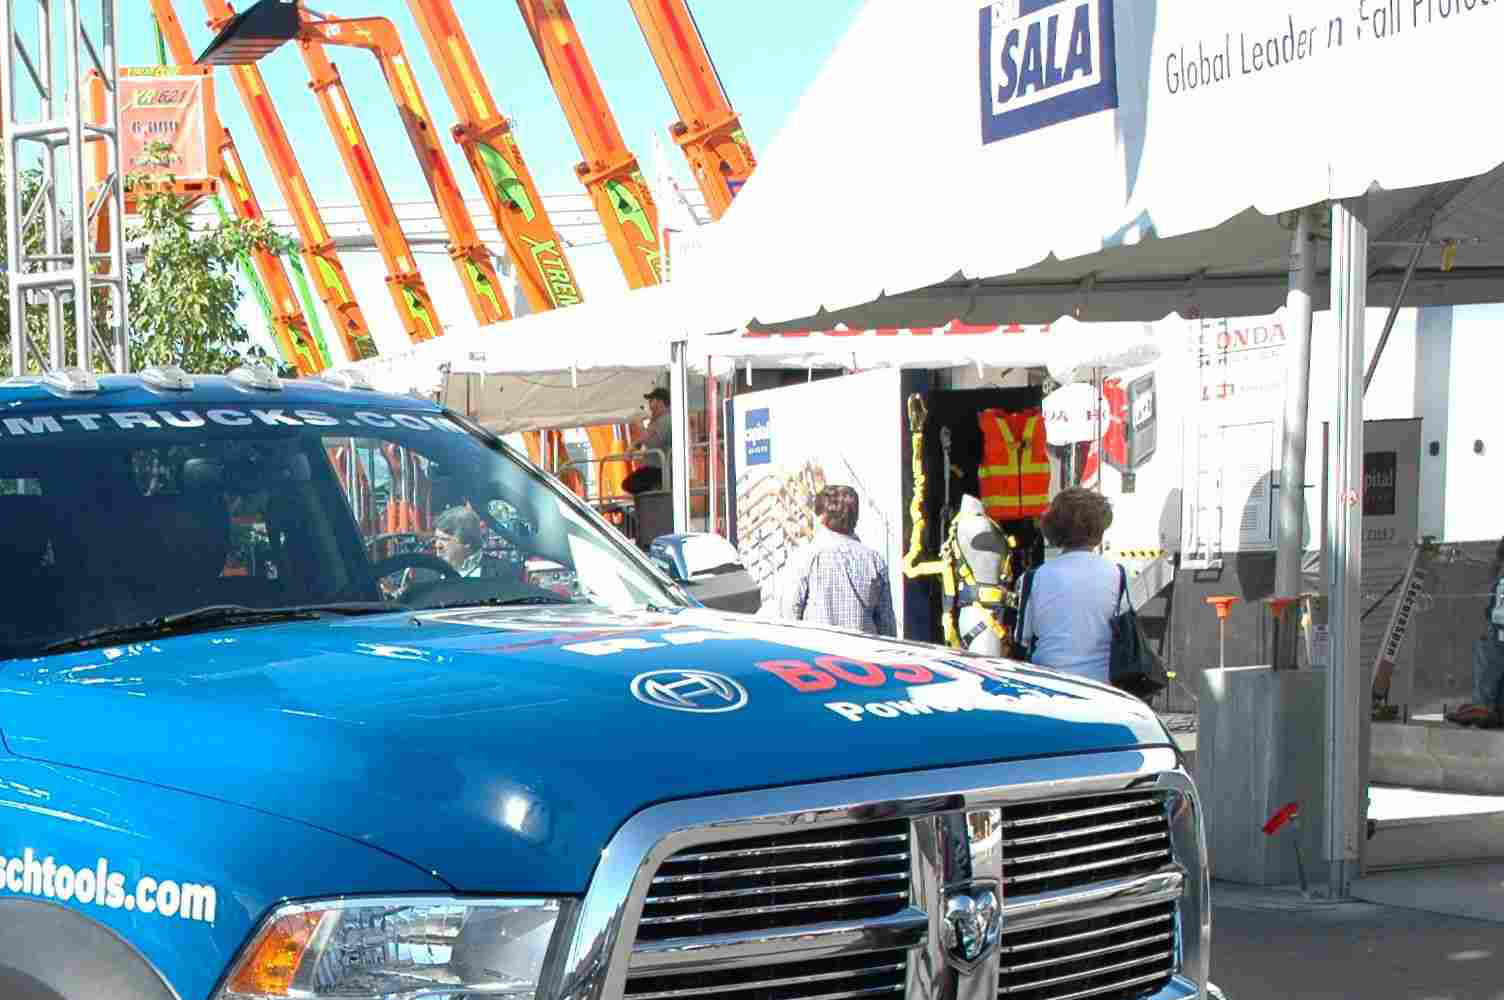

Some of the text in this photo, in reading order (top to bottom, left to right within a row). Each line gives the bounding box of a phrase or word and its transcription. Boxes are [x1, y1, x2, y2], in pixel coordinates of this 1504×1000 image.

[998, 3, 1093, 104] SALA
[1166, 33, 1231, 94] Global
[1240, 14, 1317, 74] Leader
